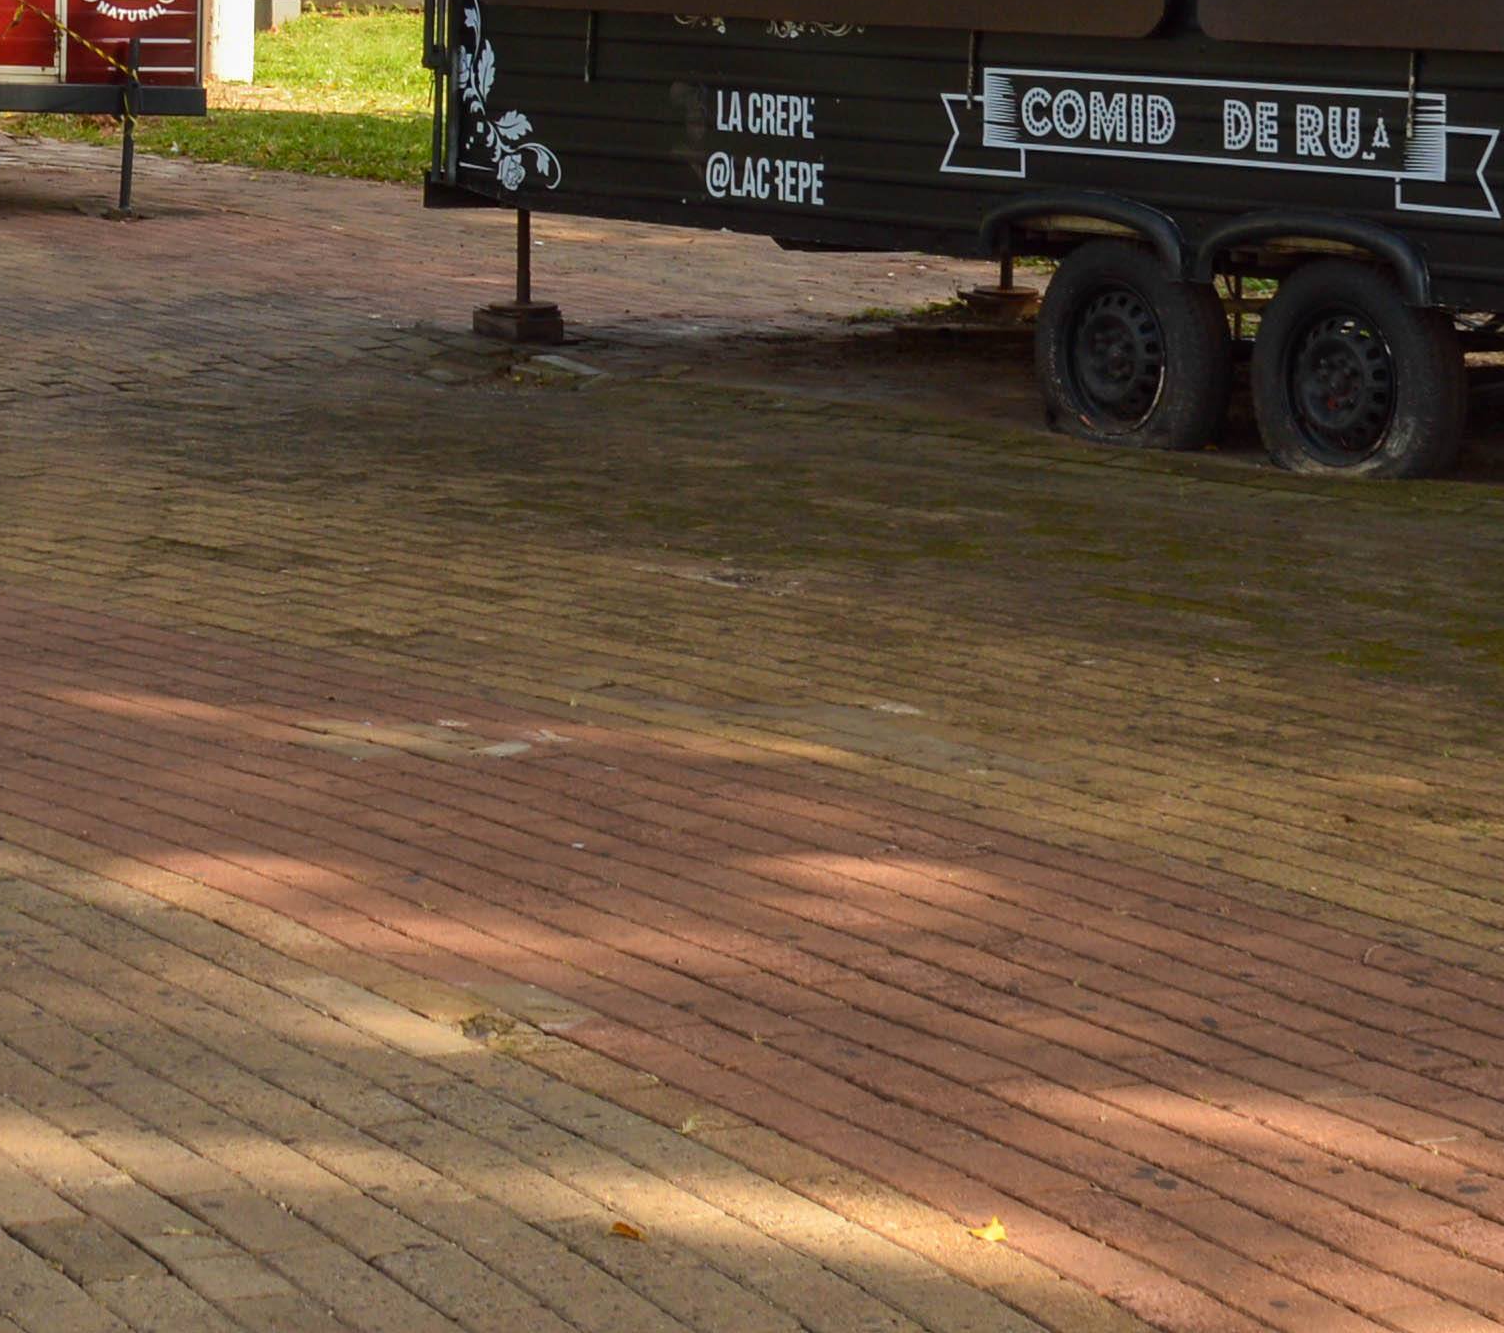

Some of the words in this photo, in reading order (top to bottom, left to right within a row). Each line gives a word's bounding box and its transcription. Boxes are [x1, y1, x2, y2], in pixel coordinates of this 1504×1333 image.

[96, 0, 167, 22] NATURAL
[717, 89, 743, 134] LA
[747, 92, 815, 139] CREPE
[1223, 98, 1278, 153] DE
